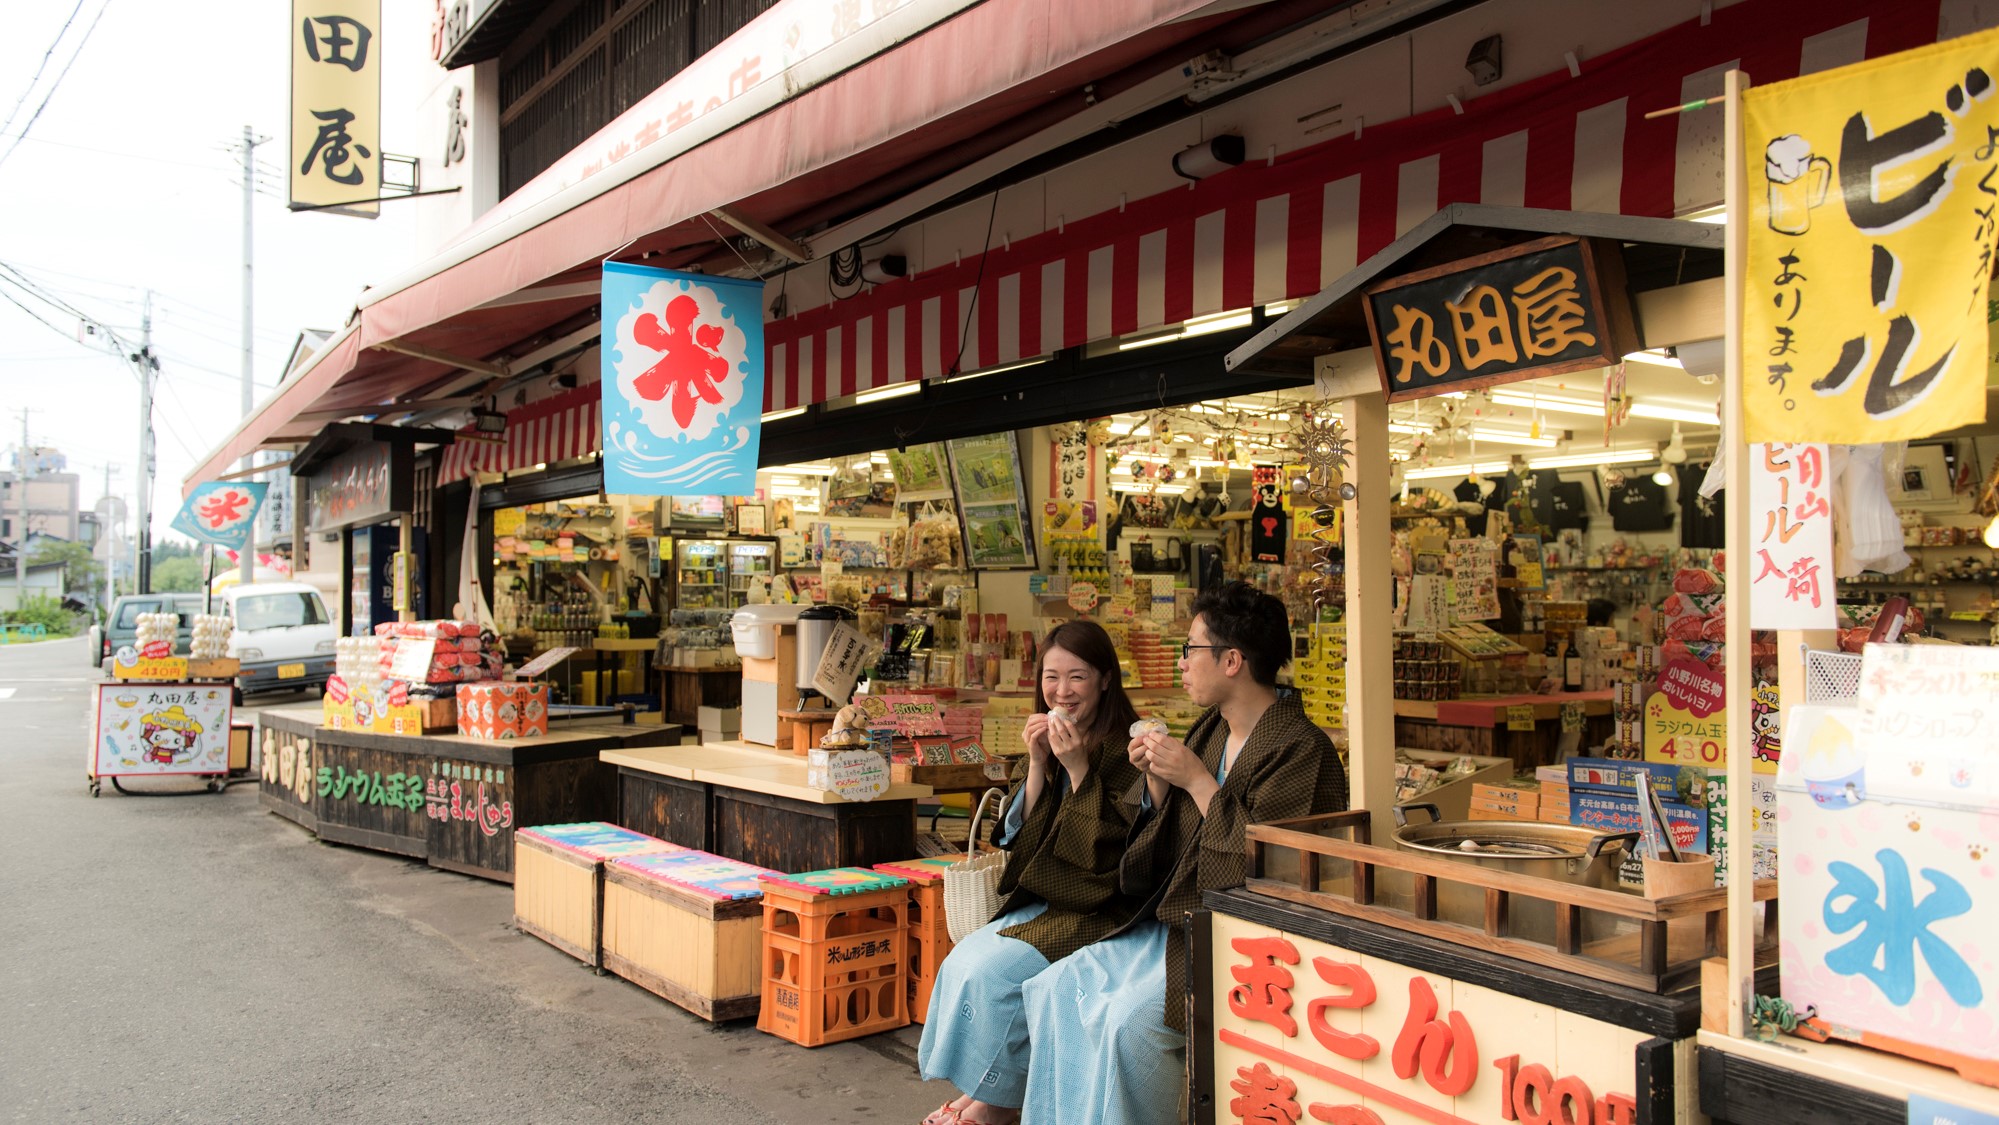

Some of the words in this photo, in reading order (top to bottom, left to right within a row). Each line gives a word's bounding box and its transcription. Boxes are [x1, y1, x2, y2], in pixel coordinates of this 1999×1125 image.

[301, 15, 373, 186] 田屋
[1811, 66, 1995, 417] ビール
[1386, 266, 1597, 383] 丸田屋
[1767, 248, 1807, 411] あります。
[633, 295, 729, 428] 氷
[199, 491, 249, 528] 氷
[1795, 446, 1830, 522] 月山
[688, 545, 717, 554] PEPSI
[737, 546, 765, 554] PEPSI
[1754, 548, 1822, 609] 入荷
[147, 690, 200, 706] 丸田屋
[1668, 666, 1723, 699] 小野川名物
[1868, 666, 1973, 696] キャラメル
[1660, 737, 1727, 764] 430
[1860, 708, 1985, 739] ミルクシロップ
[316, 765, 426, 813] ラジウム玉子
[450, 780, 513, 837] まんじゅう
[1823, 848, 1985, 1009] 氷
[1228, 936, 1480, 1097] 玉こん
